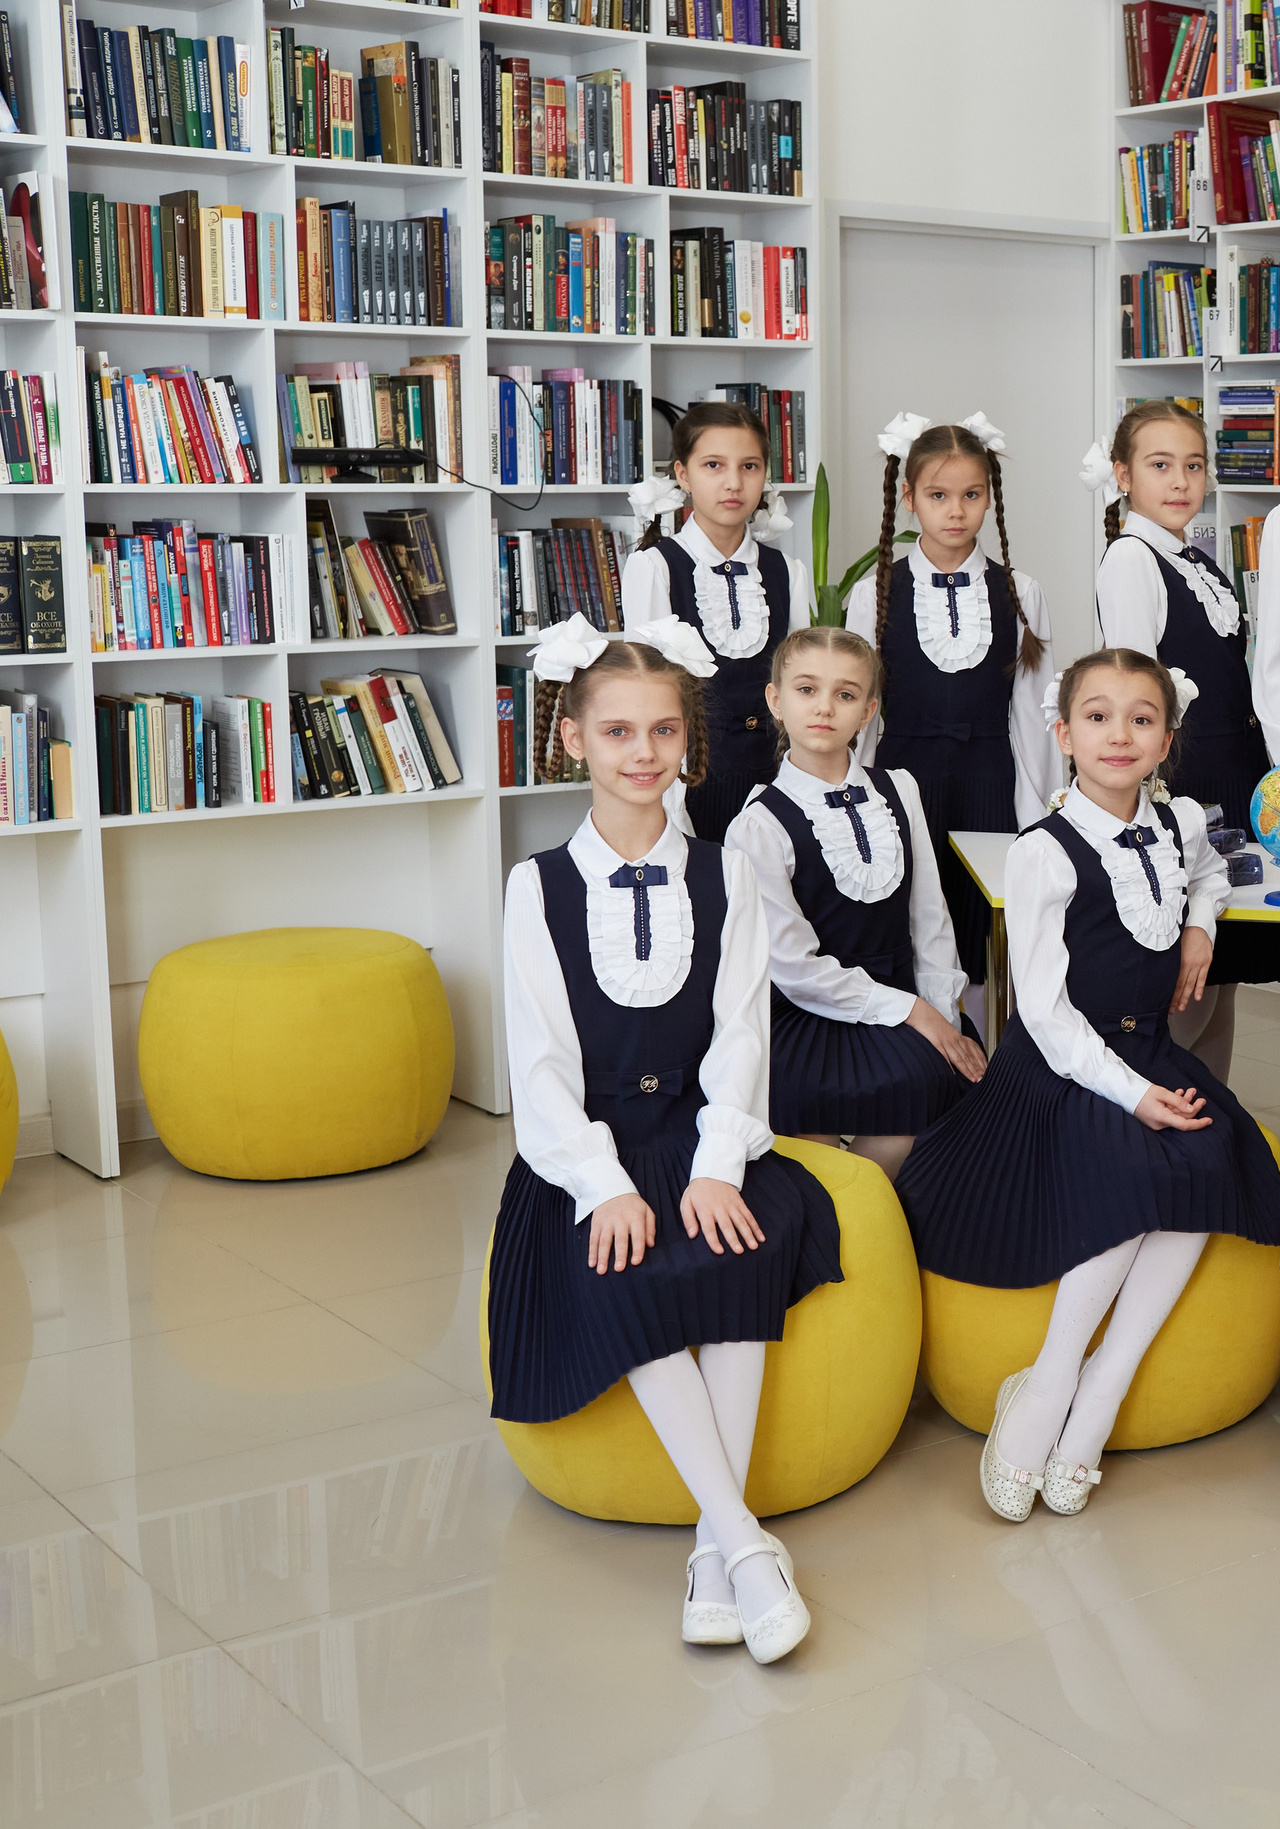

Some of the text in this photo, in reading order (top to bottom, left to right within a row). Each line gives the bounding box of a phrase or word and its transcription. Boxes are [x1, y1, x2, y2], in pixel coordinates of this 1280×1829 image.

[103, 32, 115, 95] СУДЕБНАЯ МЕДИЦИНА
[673, 89, 687, 125] РУЗВЕЛЬТ
[231, 117, 239, 137] ВАШ
[1196, 180, 1208, 192] 66
[92, 201, 100, 234] СРЕДСТВА
[93, 236, 103, 292] ЛЕКАРСТВЕННЫЕ
[166, 251, 175, 309] Глазные болезни
[361, 247, 369, 285] РОМАНОВЫ
[375, 260, 383, 282] ПЕТР
[1209, 310, 1220, 321] 67
[117, 403, 128, 449] НЕ НАВРЕДИ
[138, 385, 154, 447] ИЗ СОСУДА СВОЕГО
[211, 390, 230, 442] НАРКОМАНИЯ
[234, 403, 247, 436] БЕЗ ДНА
[35, 411, 48, 466] ЛЕЧЕБНЫЕ ТРАВЫ
[545, 430, 553, 452] КВЖД
[136, 460, 144, 479] Просто
[199, 447, 211, 477] СПРАВОЧНИК
[607, 547, 616, 573] СМЕРТЬ
[227, 569, 235, 611] ПРИЗВАНИЕ
[36, 612, 57, 621] ВСЕ
[39, 620, 63, 628] ОХОТЕ
[312, 708, 327, 740] ГРОЗНЫЙ
[321, 711, 330, 732] ИВАН
[176, 769, 181, 778] ПО
[195, 742, 204, 783] КОРОНАВИРУС
[17, 796, 25, 817] СПОК
